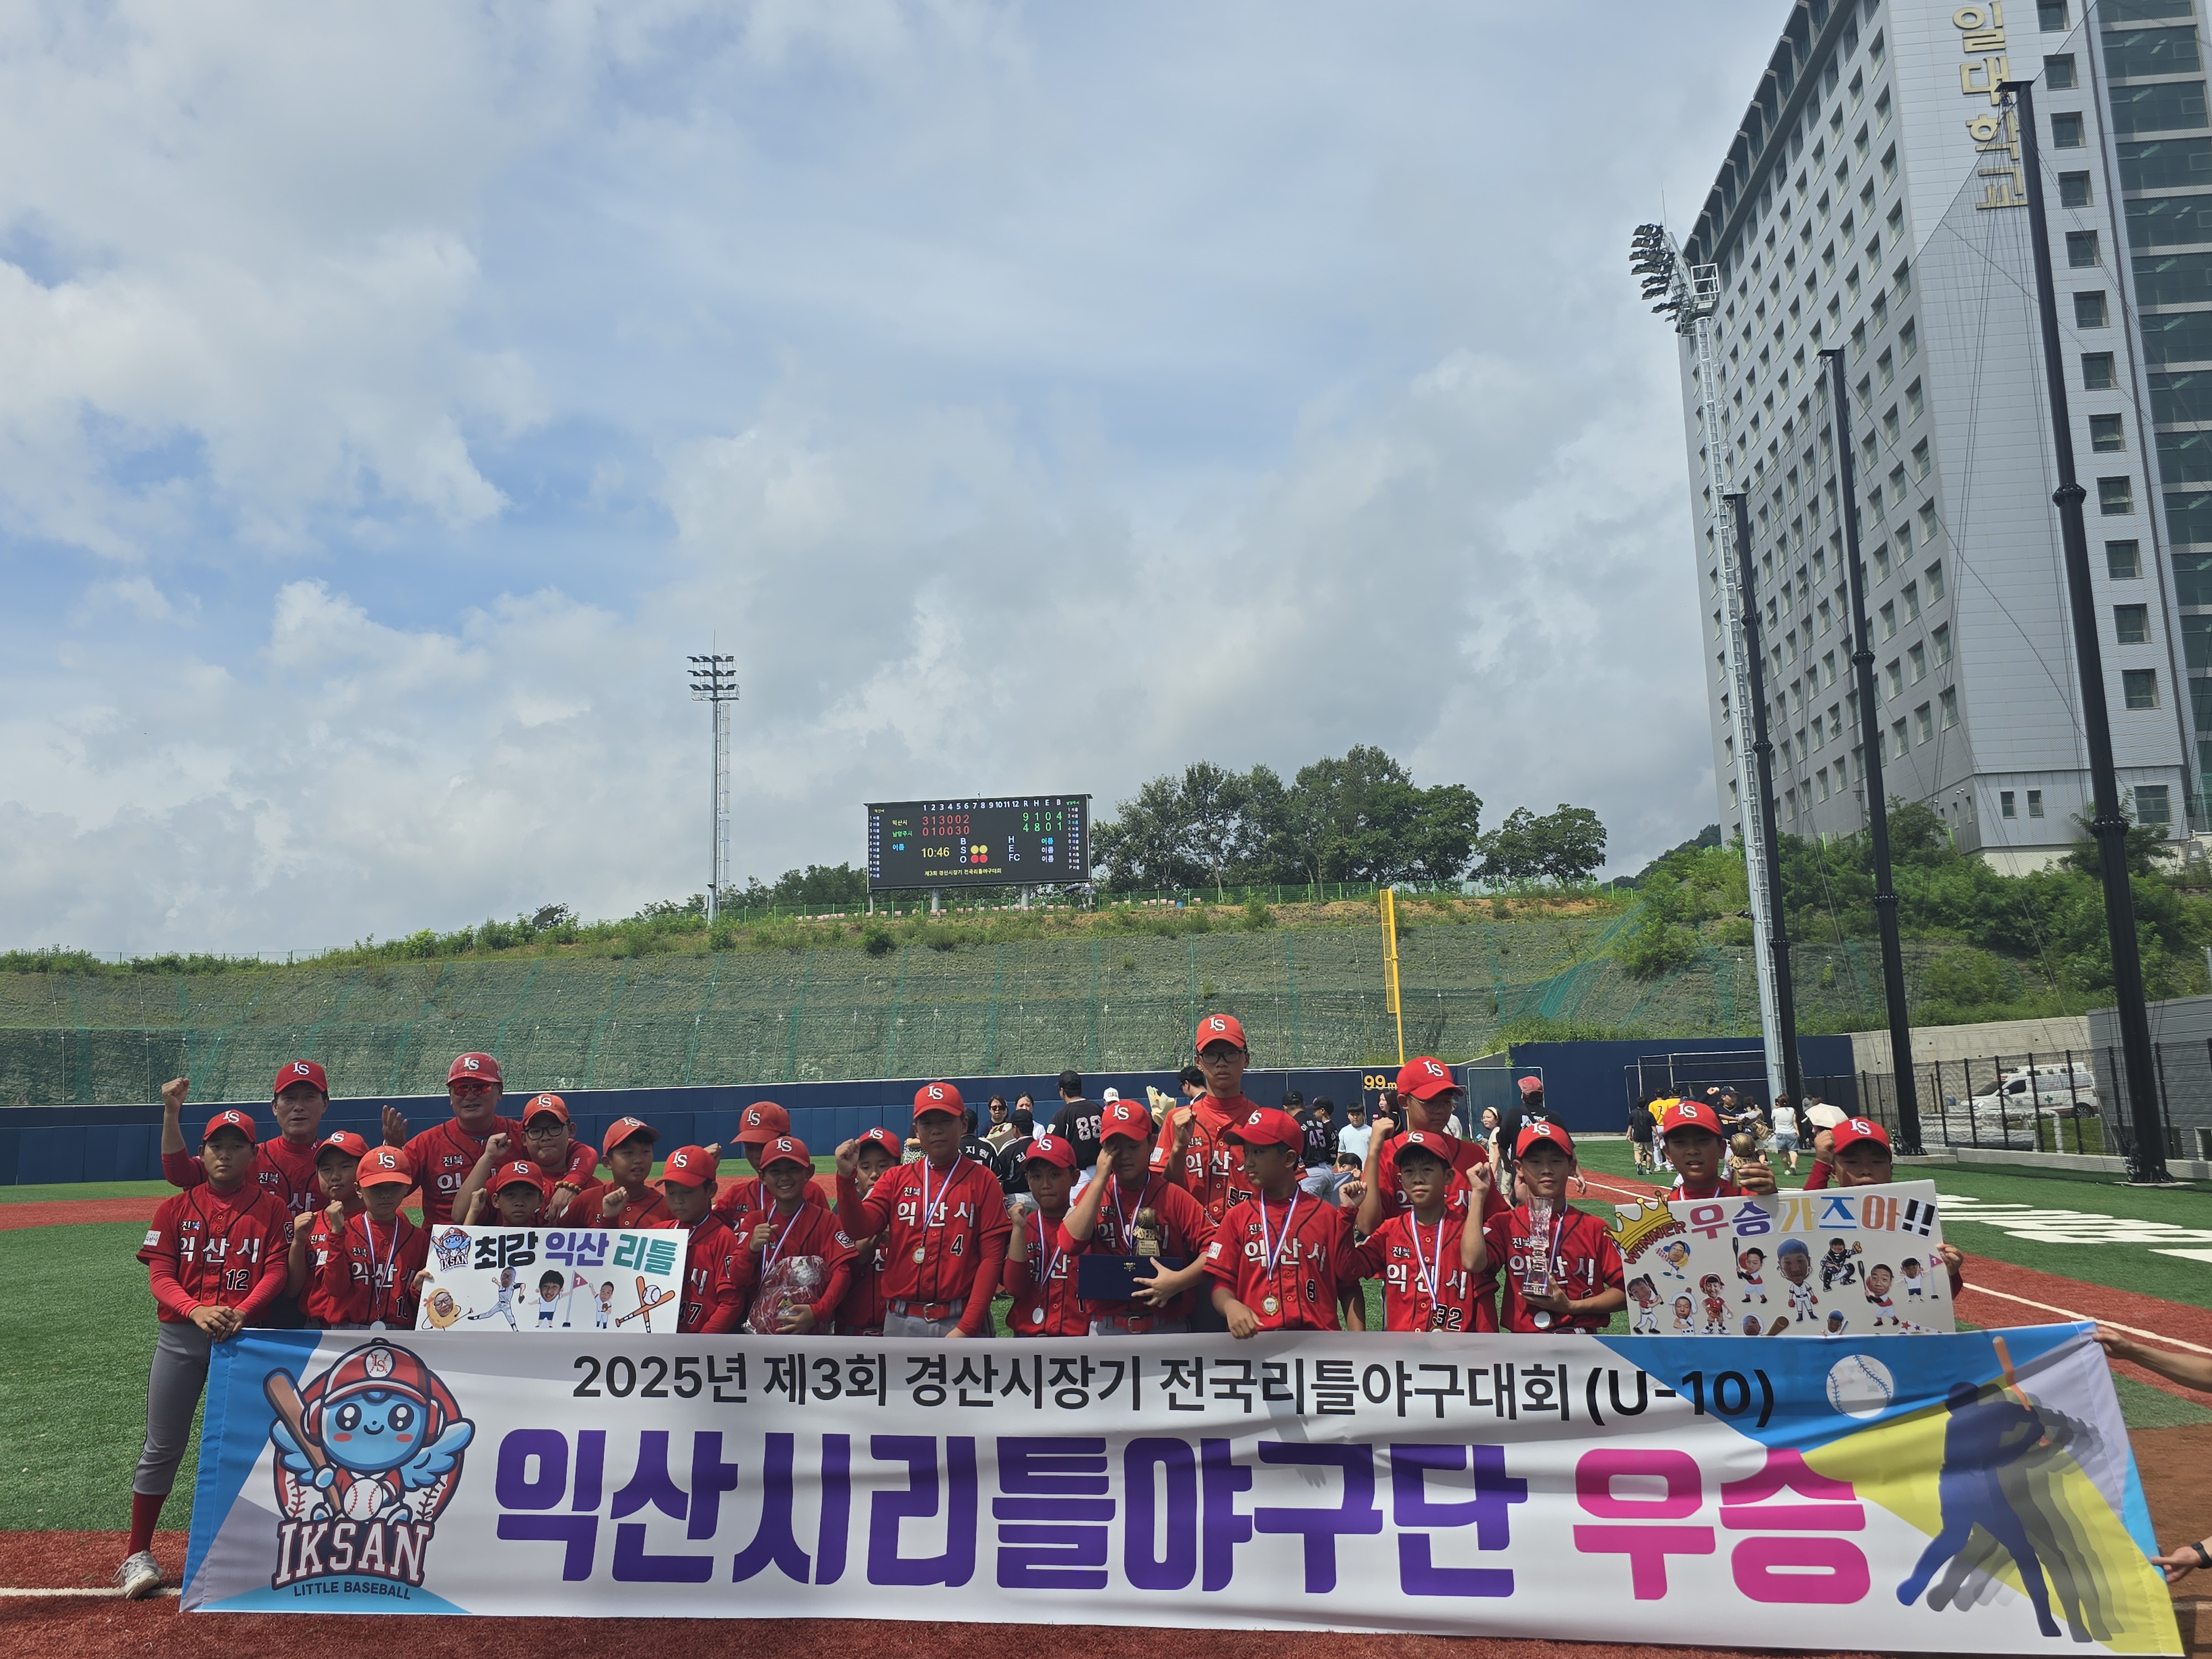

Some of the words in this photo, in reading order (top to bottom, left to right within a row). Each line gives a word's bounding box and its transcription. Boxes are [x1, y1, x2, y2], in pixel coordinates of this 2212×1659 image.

[922, 816, 928, 825] 3
[931, 816, 936, 825] 1
[938, 816, 945, 825] 3
[947, 815, 953, 824] 0
[955, 815, 961, 824] 0
[963, 814, 969, 823] 2
[1022, 812, 1029, 821] 9
[1034, 812, 1039, 821] 1
[1045, 812, 1051, 821] 0
[1056, 811, 1062, 820] 4
[922, 827, 928, 836] 0
[931, 827, 936, 836] 1
[938, 827, 945, 836] 0
[947, 826, 953, 836] 0
[955, 826, 961, 834] 3
[963, 826, 969, 834] 0
[1022, 823, 1029, 832] 4
[1034, 823, 1040, 832] 8
[1046, 822, 1051, 831] 0
[1057, 822, 1062, 831] 1
[921, 847, 950, 858] 10:46
[1009, 853, 1021, 862] FC
[443, 1155, 464, 1167] 전북
[1186, 1150, 1245, 1178] 익산
[258, 1172, 279, 1184] 전북
[182, 1220, 201, 1231] 전북
[898, 1202, 974, 1227] 익산시
[180, 1237, 260, 1263] 익산시
[474, 1231, 539, 1270] 최강
[545, 1232, 609, 1266] 익산
[613, 1234, 677, 1276] 리틀
[950, 1234, 963, 1256] 4
[1624, 1220, 1687, 1265] WINNER
[440, 1255, 468, 1270] IKSAN
[1244, 1238, 1326, 1272] 익산시
[226, 1269, 250, 1291] 12
[1306, 1279, 1316, 1302] 8
[1432, 1303, 1463, 1331] 32
[572, 1355, 748, 1404] 2025년
[763, 1354, 886, 1407] 제3회
[905, 1353, 1141, 1413] 경산시장기
[1160, 1357, 1570, 1421] 전국리틀야구대회
[1587, 1366, 1774, 1428] (U-10)
[495, 1428, 1528, 1598] 익산시리틀야구단
[1572, 1447, 1871, 1604] 우승
[276, 1522, 430, 1585] IKSAN
[294, 1582, 339, 1597] LITTLE
[343, 1582, 411, 1600] BASEBALL
